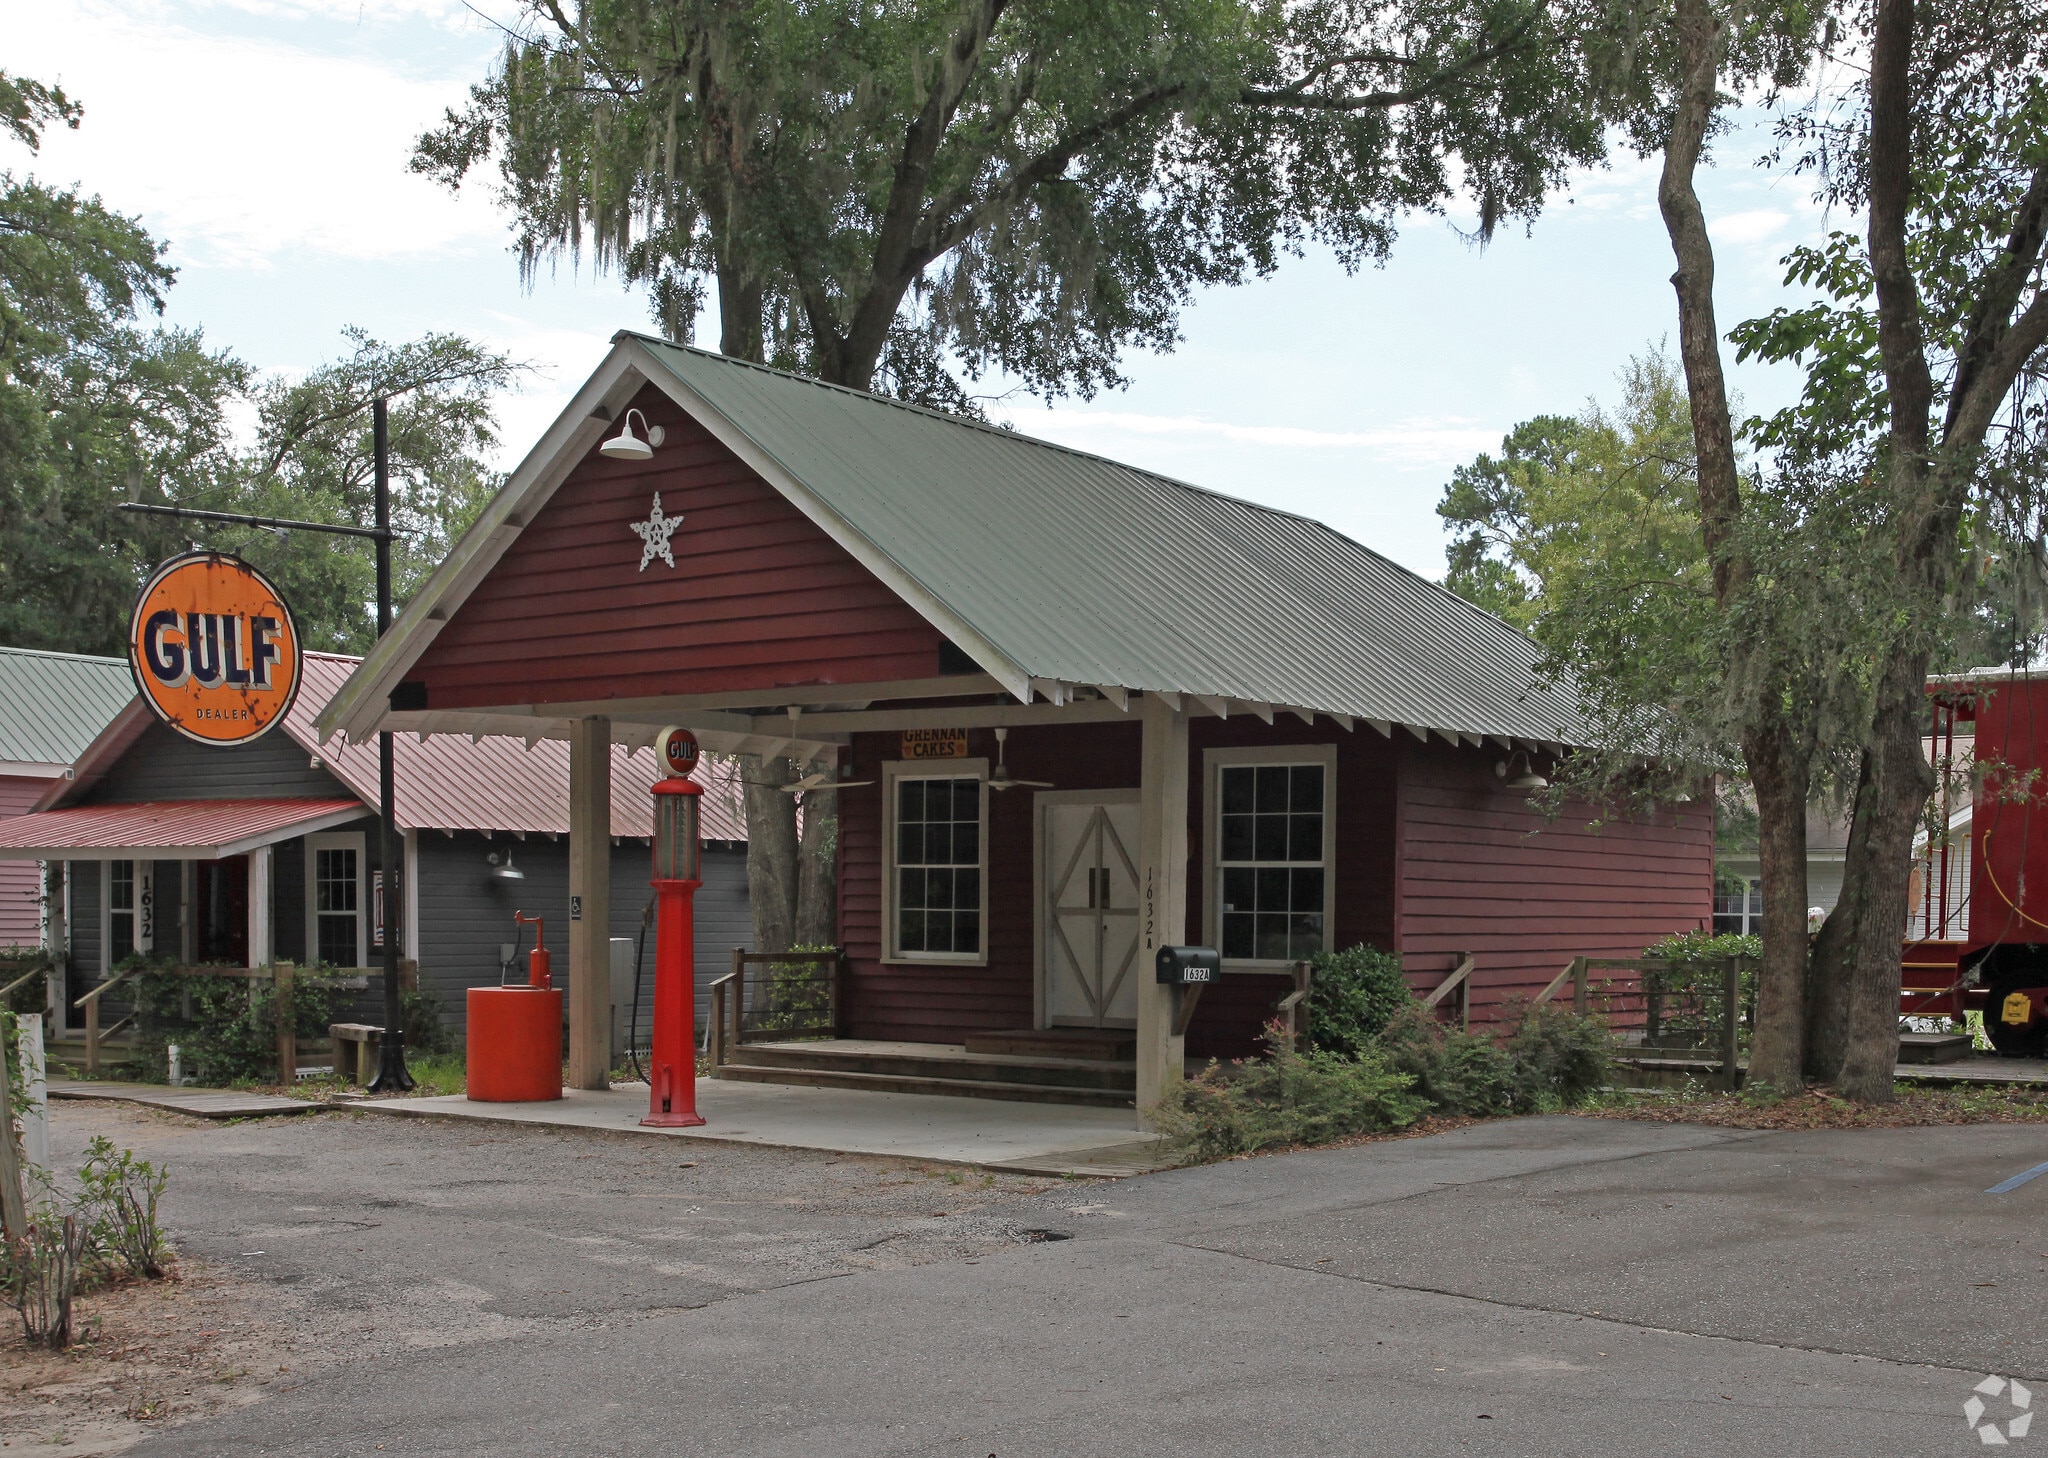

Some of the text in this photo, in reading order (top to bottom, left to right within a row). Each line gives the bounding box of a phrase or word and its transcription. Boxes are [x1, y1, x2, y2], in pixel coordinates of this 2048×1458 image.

[144, 610, 283, 691] GULF
[196, 708, 249, 721] DEALER
[669, 741, 697, 760] GULF
[913, 742, 955, 757] CAKES
[142, 876, 152, 938] 1632
[1185, 967, 1209, 980] 1632A
